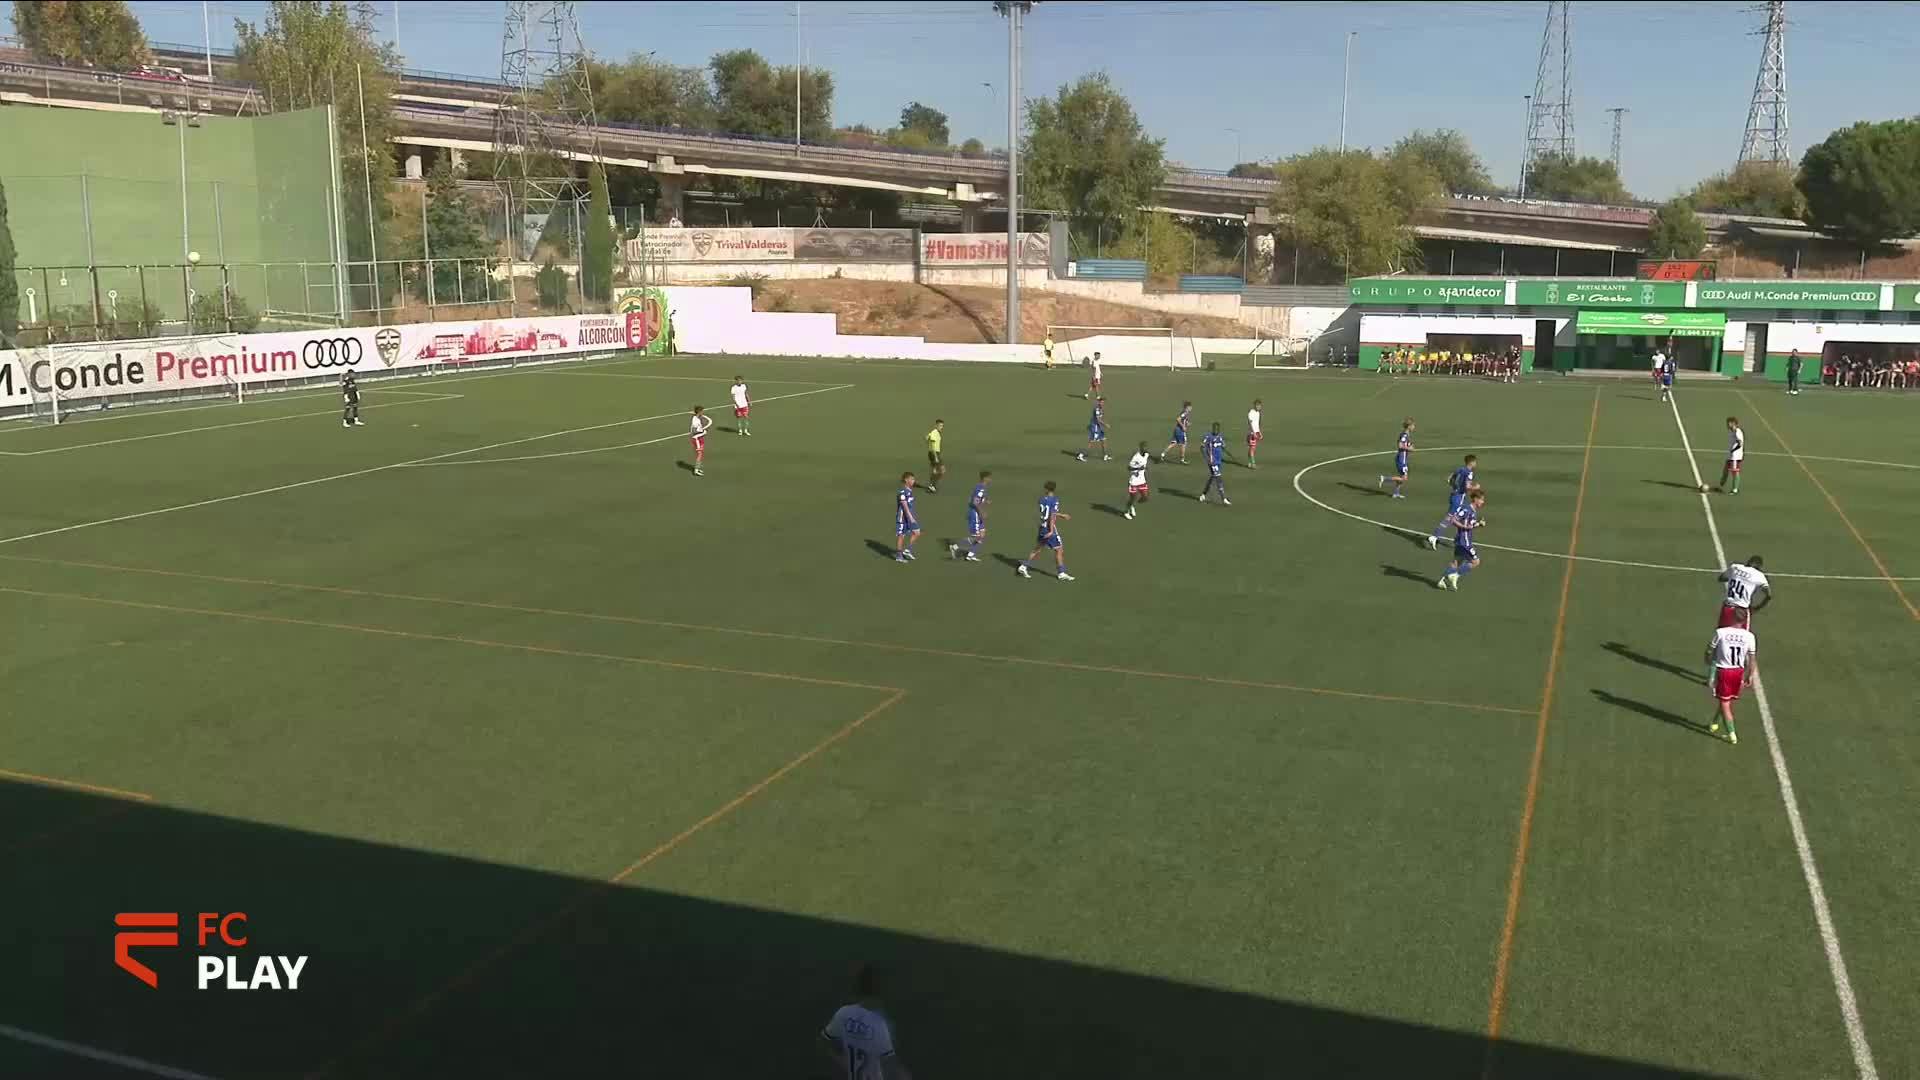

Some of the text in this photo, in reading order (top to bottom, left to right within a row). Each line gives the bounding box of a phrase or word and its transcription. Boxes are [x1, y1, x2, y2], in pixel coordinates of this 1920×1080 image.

[1352, 285, 1502, 303] GRUPO afandecor
[1727, 291, 1849, 300] Audi M.Conde Premium
[155, 346, 297, 382] Premium
[1727, 578, 1745, 600] 24
[1729, 646, 1742, 666] 11
